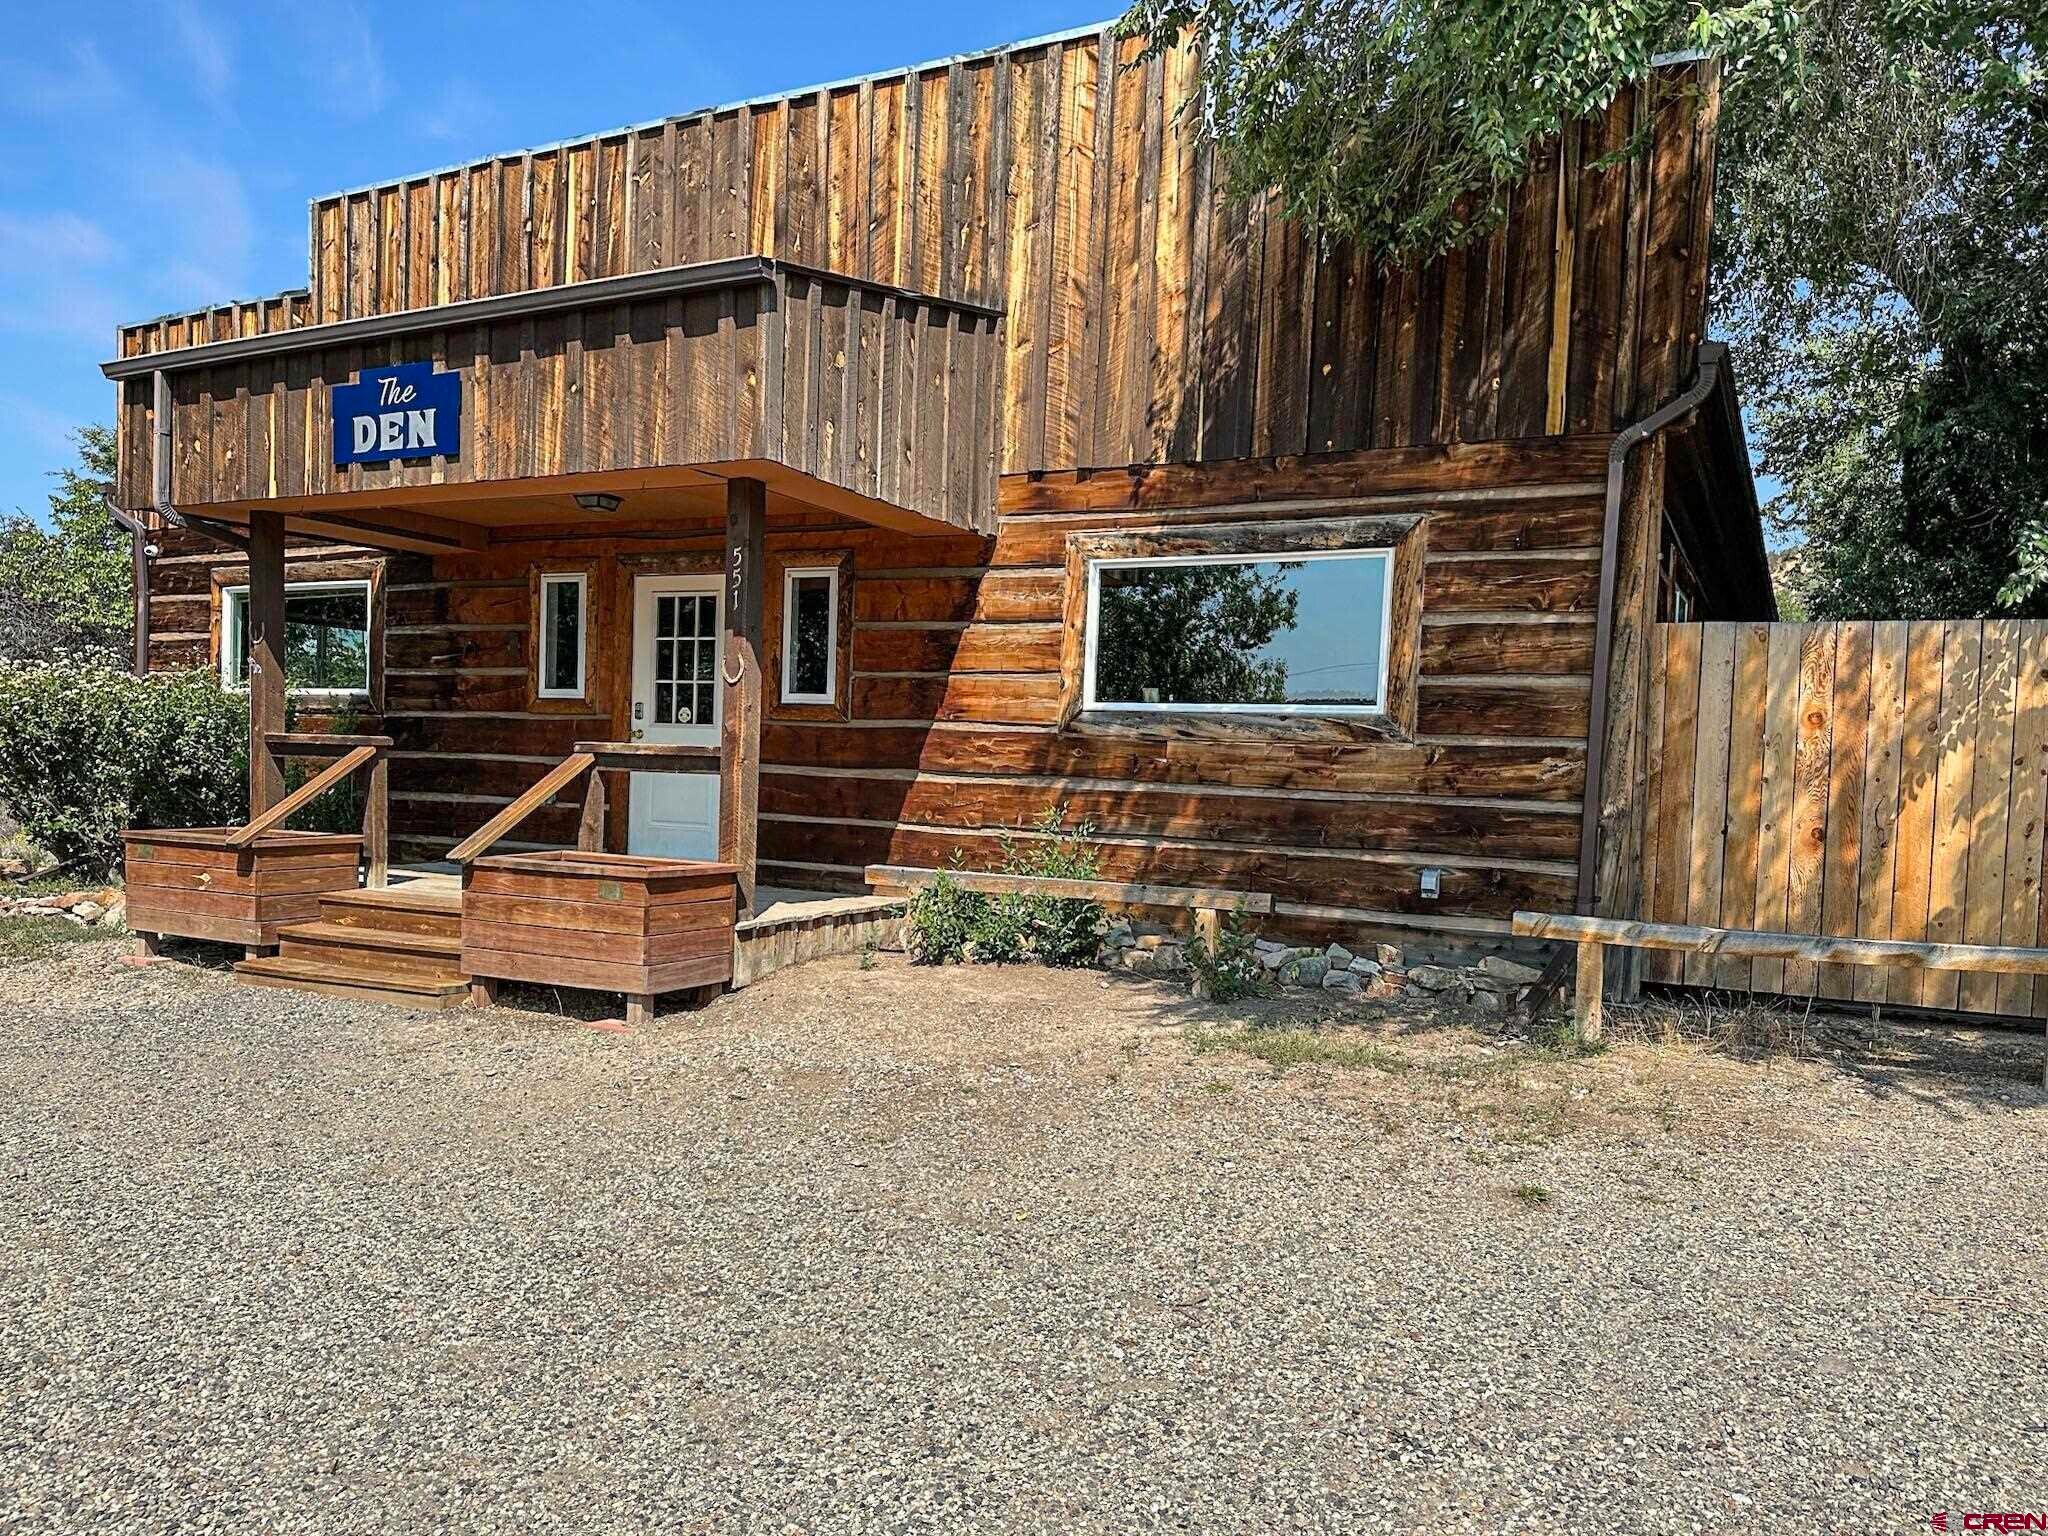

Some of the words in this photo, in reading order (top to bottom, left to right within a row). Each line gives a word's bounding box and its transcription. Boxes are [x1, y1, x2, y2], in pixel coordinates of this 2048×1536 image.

[378, 377, 416, 406] The
[352, 408, 437, 454] DEN
[732, 546, 742, 611] 551
